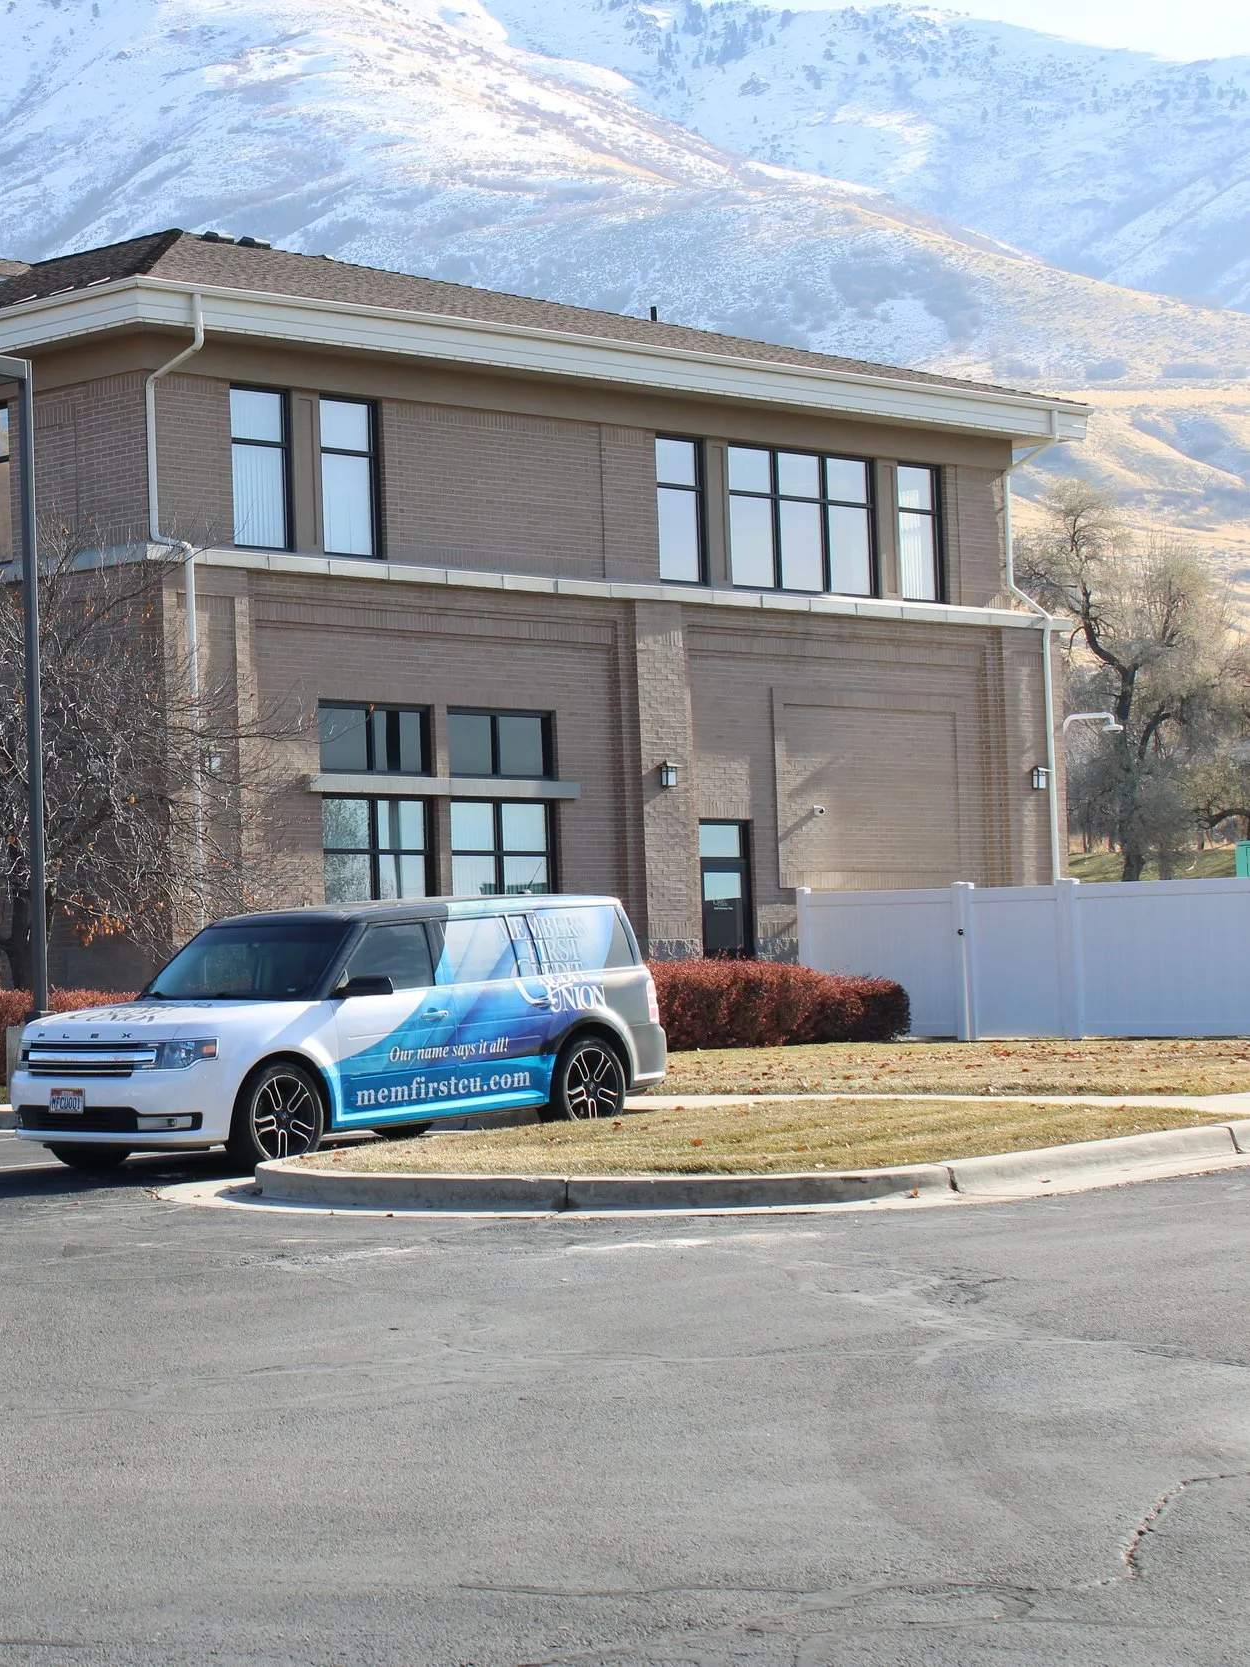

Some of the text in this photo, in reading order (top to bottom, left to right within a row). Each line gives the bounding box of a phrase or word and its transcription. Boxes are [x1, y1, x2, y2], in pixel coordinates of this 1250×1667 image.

[527, 939, 581, 962] FIRST
[546, 985, 608, 1012] UNION
[390, 1036, 509, 1062] Our name says it all!
[356, 1071, 531, 1106] memfirstcu.com
